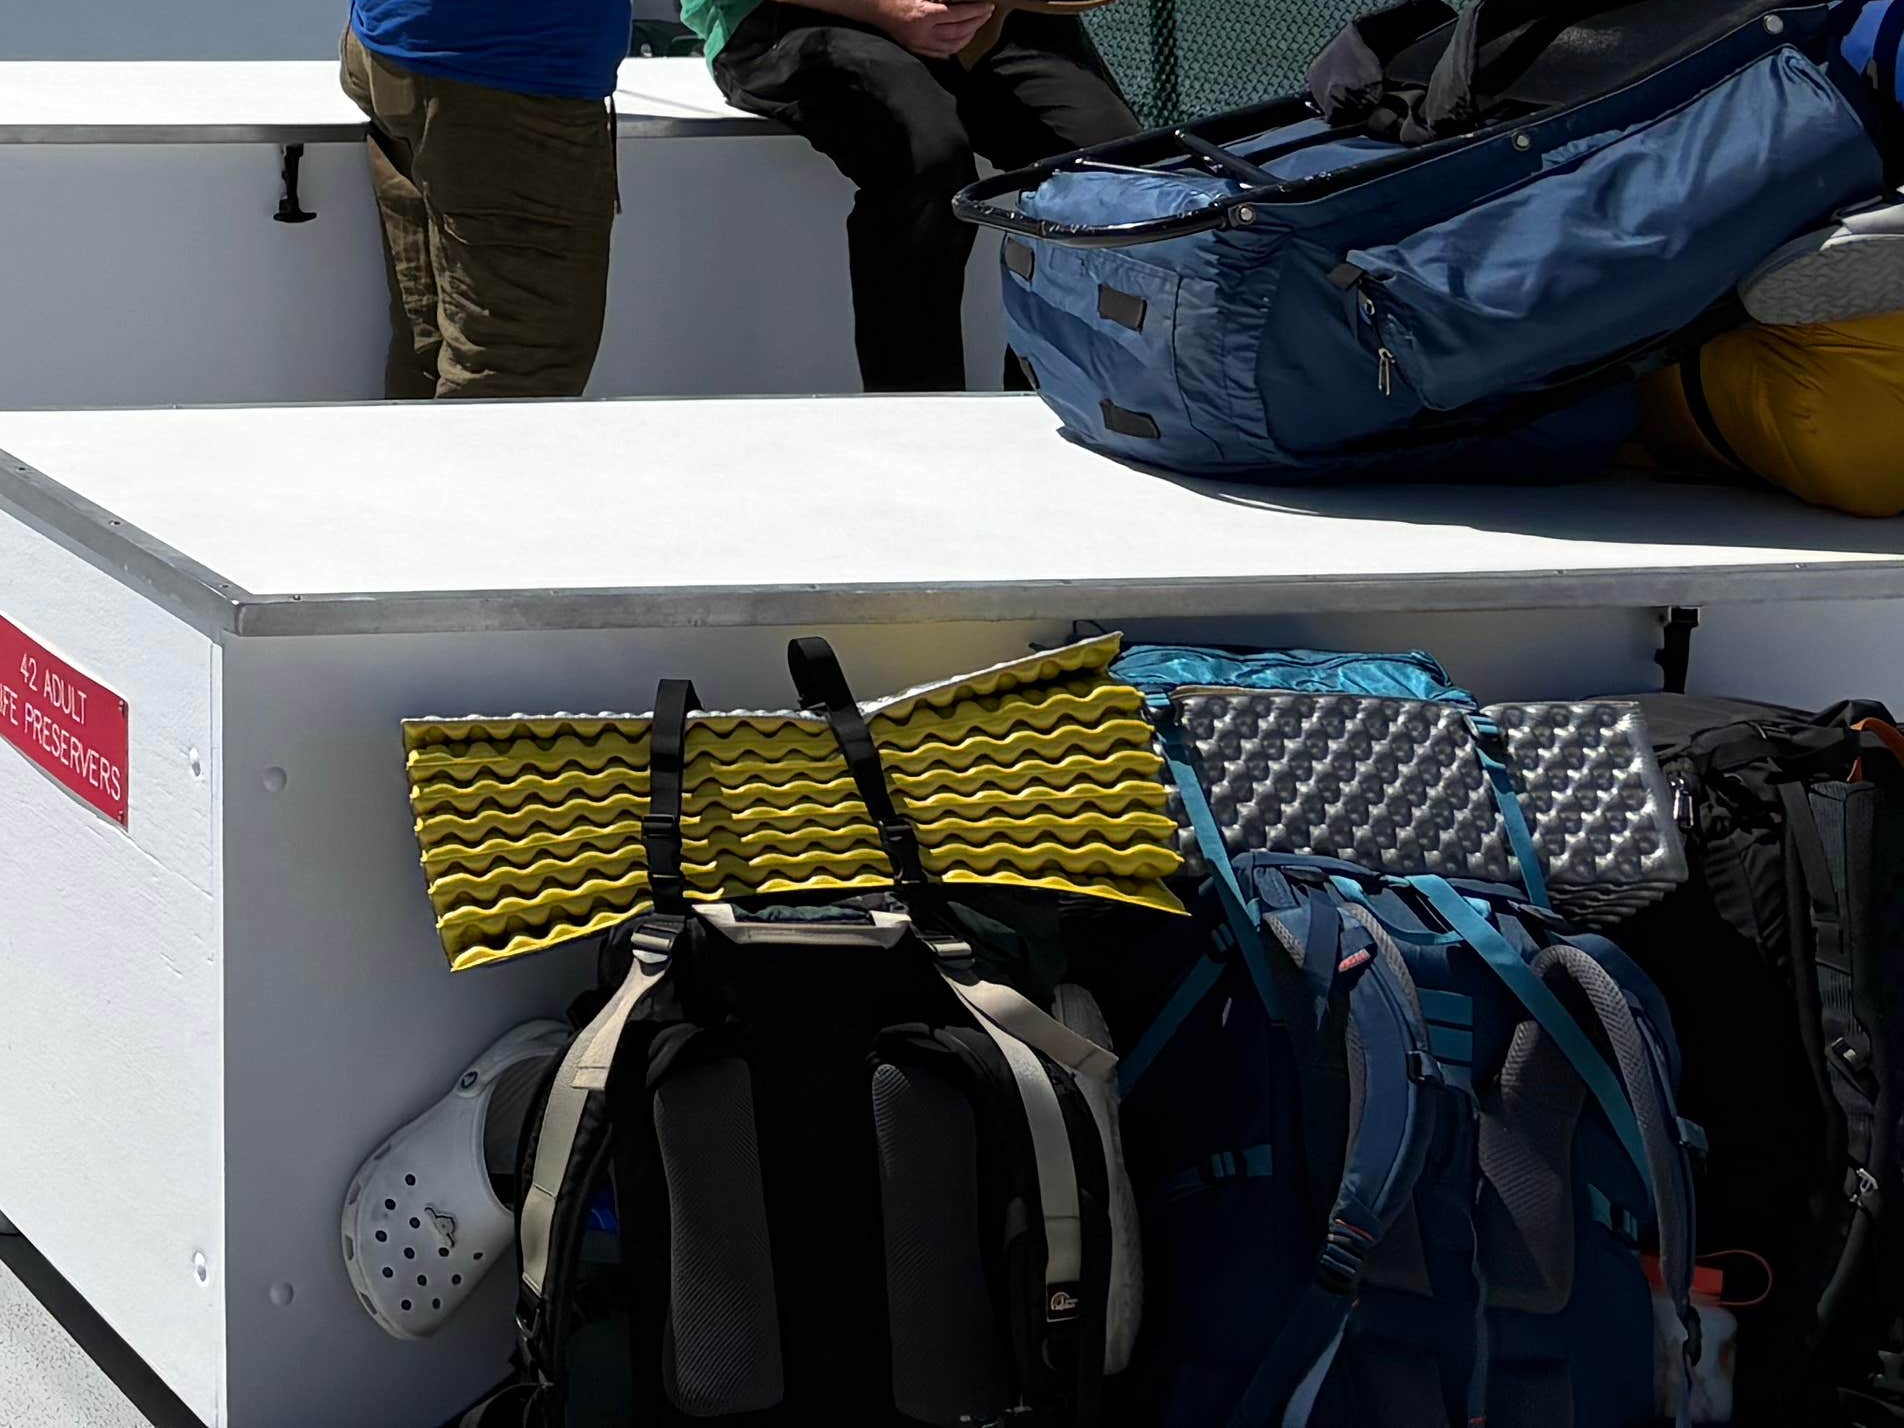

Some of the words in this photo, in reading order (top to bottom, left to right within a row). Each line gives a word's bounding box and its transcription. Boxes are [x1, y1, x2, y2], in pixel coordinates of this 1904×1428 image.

[19, 653, 39, 692] 42
[43, 669, 88, 725] ADULT
[24, 702, 121, 801] PRESERVERS
